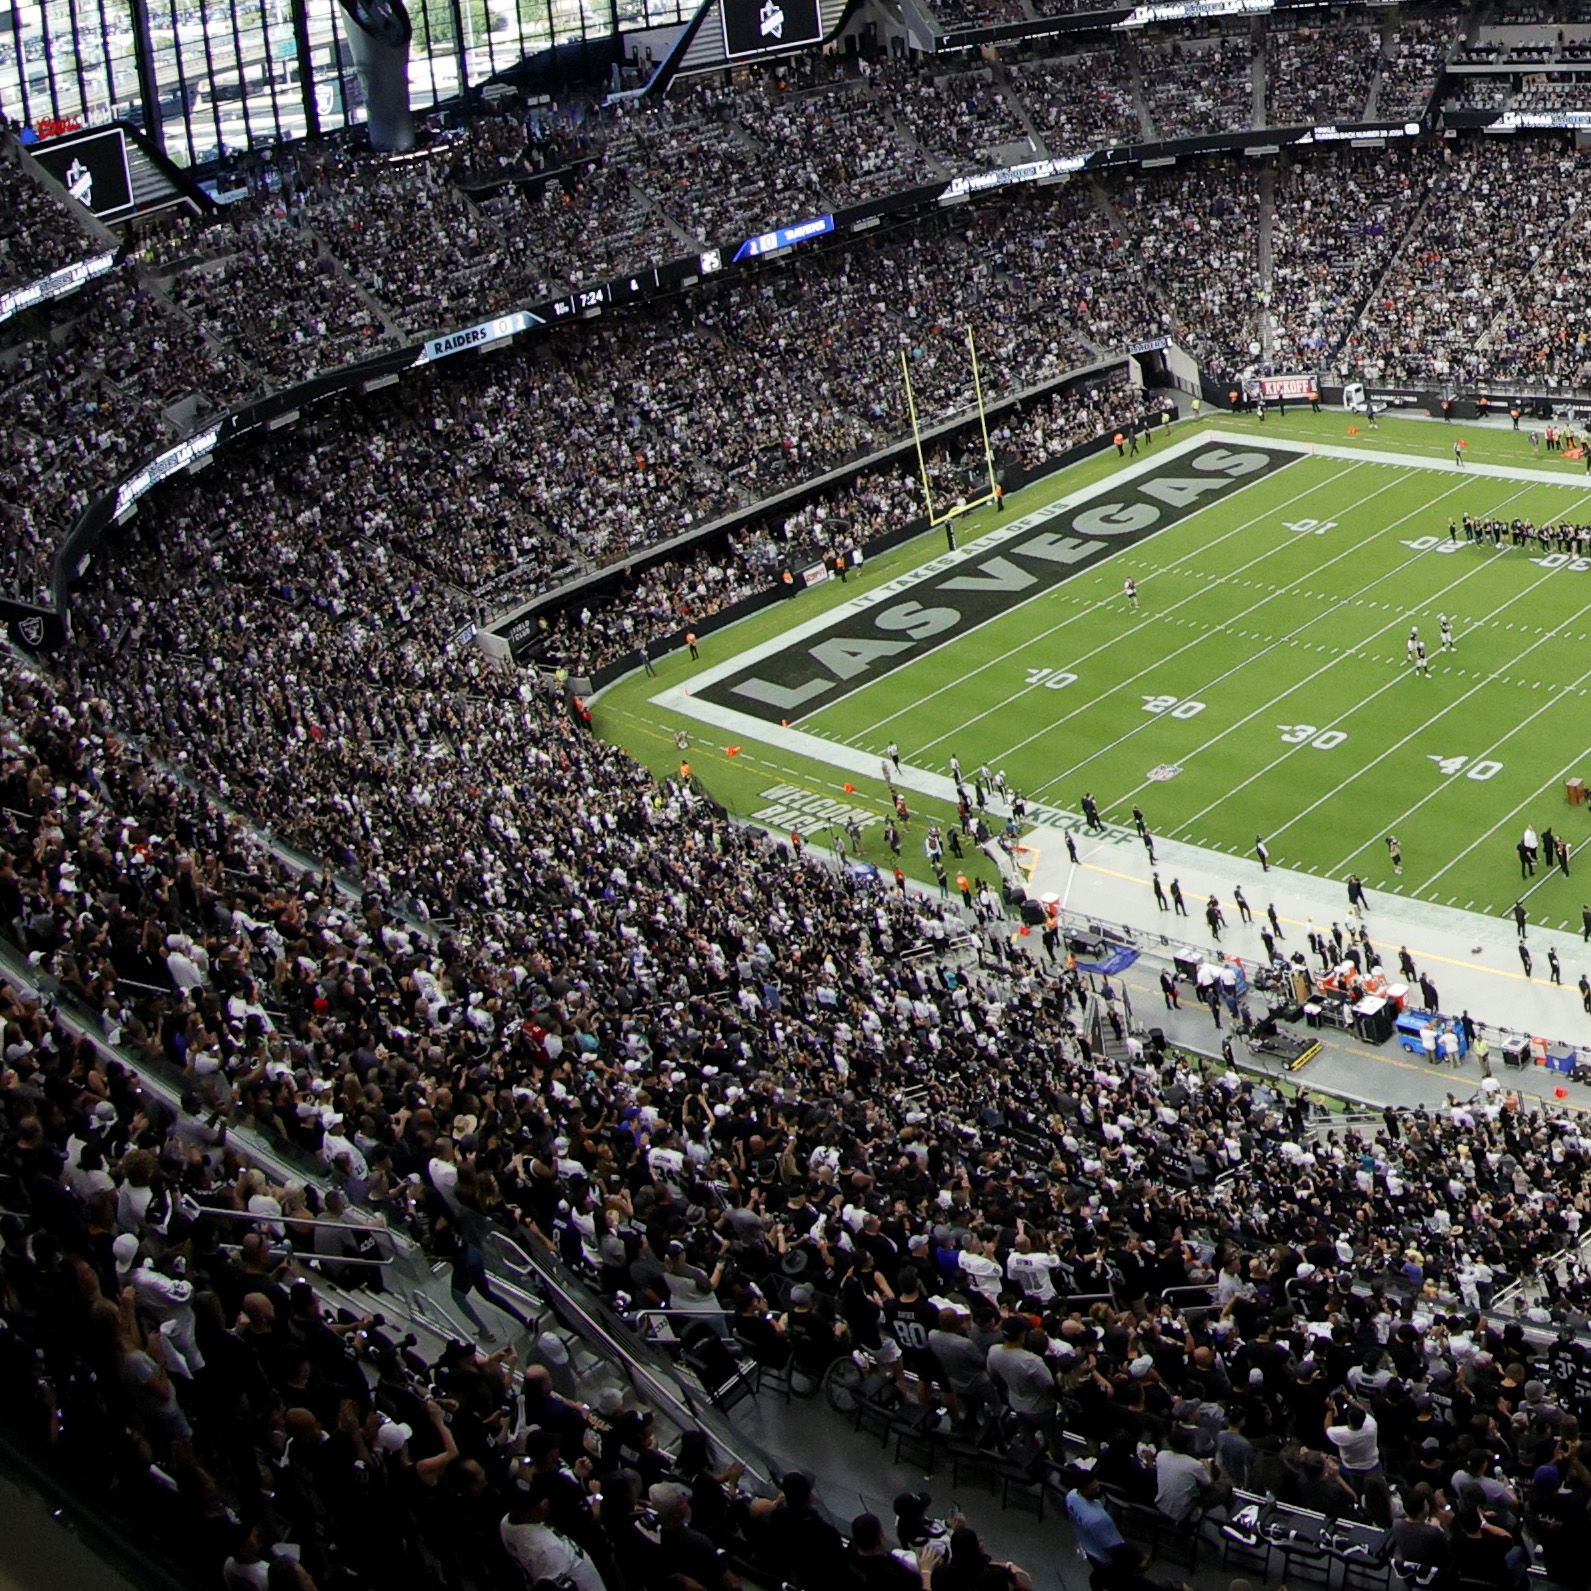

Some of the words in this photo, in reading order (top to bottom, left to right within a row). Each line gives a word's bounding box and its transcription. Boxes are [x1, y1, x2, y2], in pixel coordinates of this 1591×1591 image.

[434, 328, 487, 355] RAIDERS
[579, 289, 603, 307] 7:24
[1265, 379, 1309, 395] KICKOFF
[1290, 518, 1338, 535] 10
[851, 596, 875, 608] IT
[880, 557, 956, 592] TAKES
[962, 536, 1006, 556] ALL
[1006, 518, 1033, 533] OF
[1037, 503, 1070, 517] US
[1409, 536, 1468, 554] 20
[731, 600, 962, 709] LAS
[934, 448, 1270, 593] VEGAS
[1024, 668, 1079, 689] 10
[1141, 695, 1207, 719] 20
[1280, 724, 1348, 750] 30
[1438, 755, 1504, 780] 40
[750, 802, 829, 838] BACK
[758, 783, 887, 829] WELCOME
[1026, 807, 1139, 846] KICKOFF
[892, 1320, 927, 1350] 80
